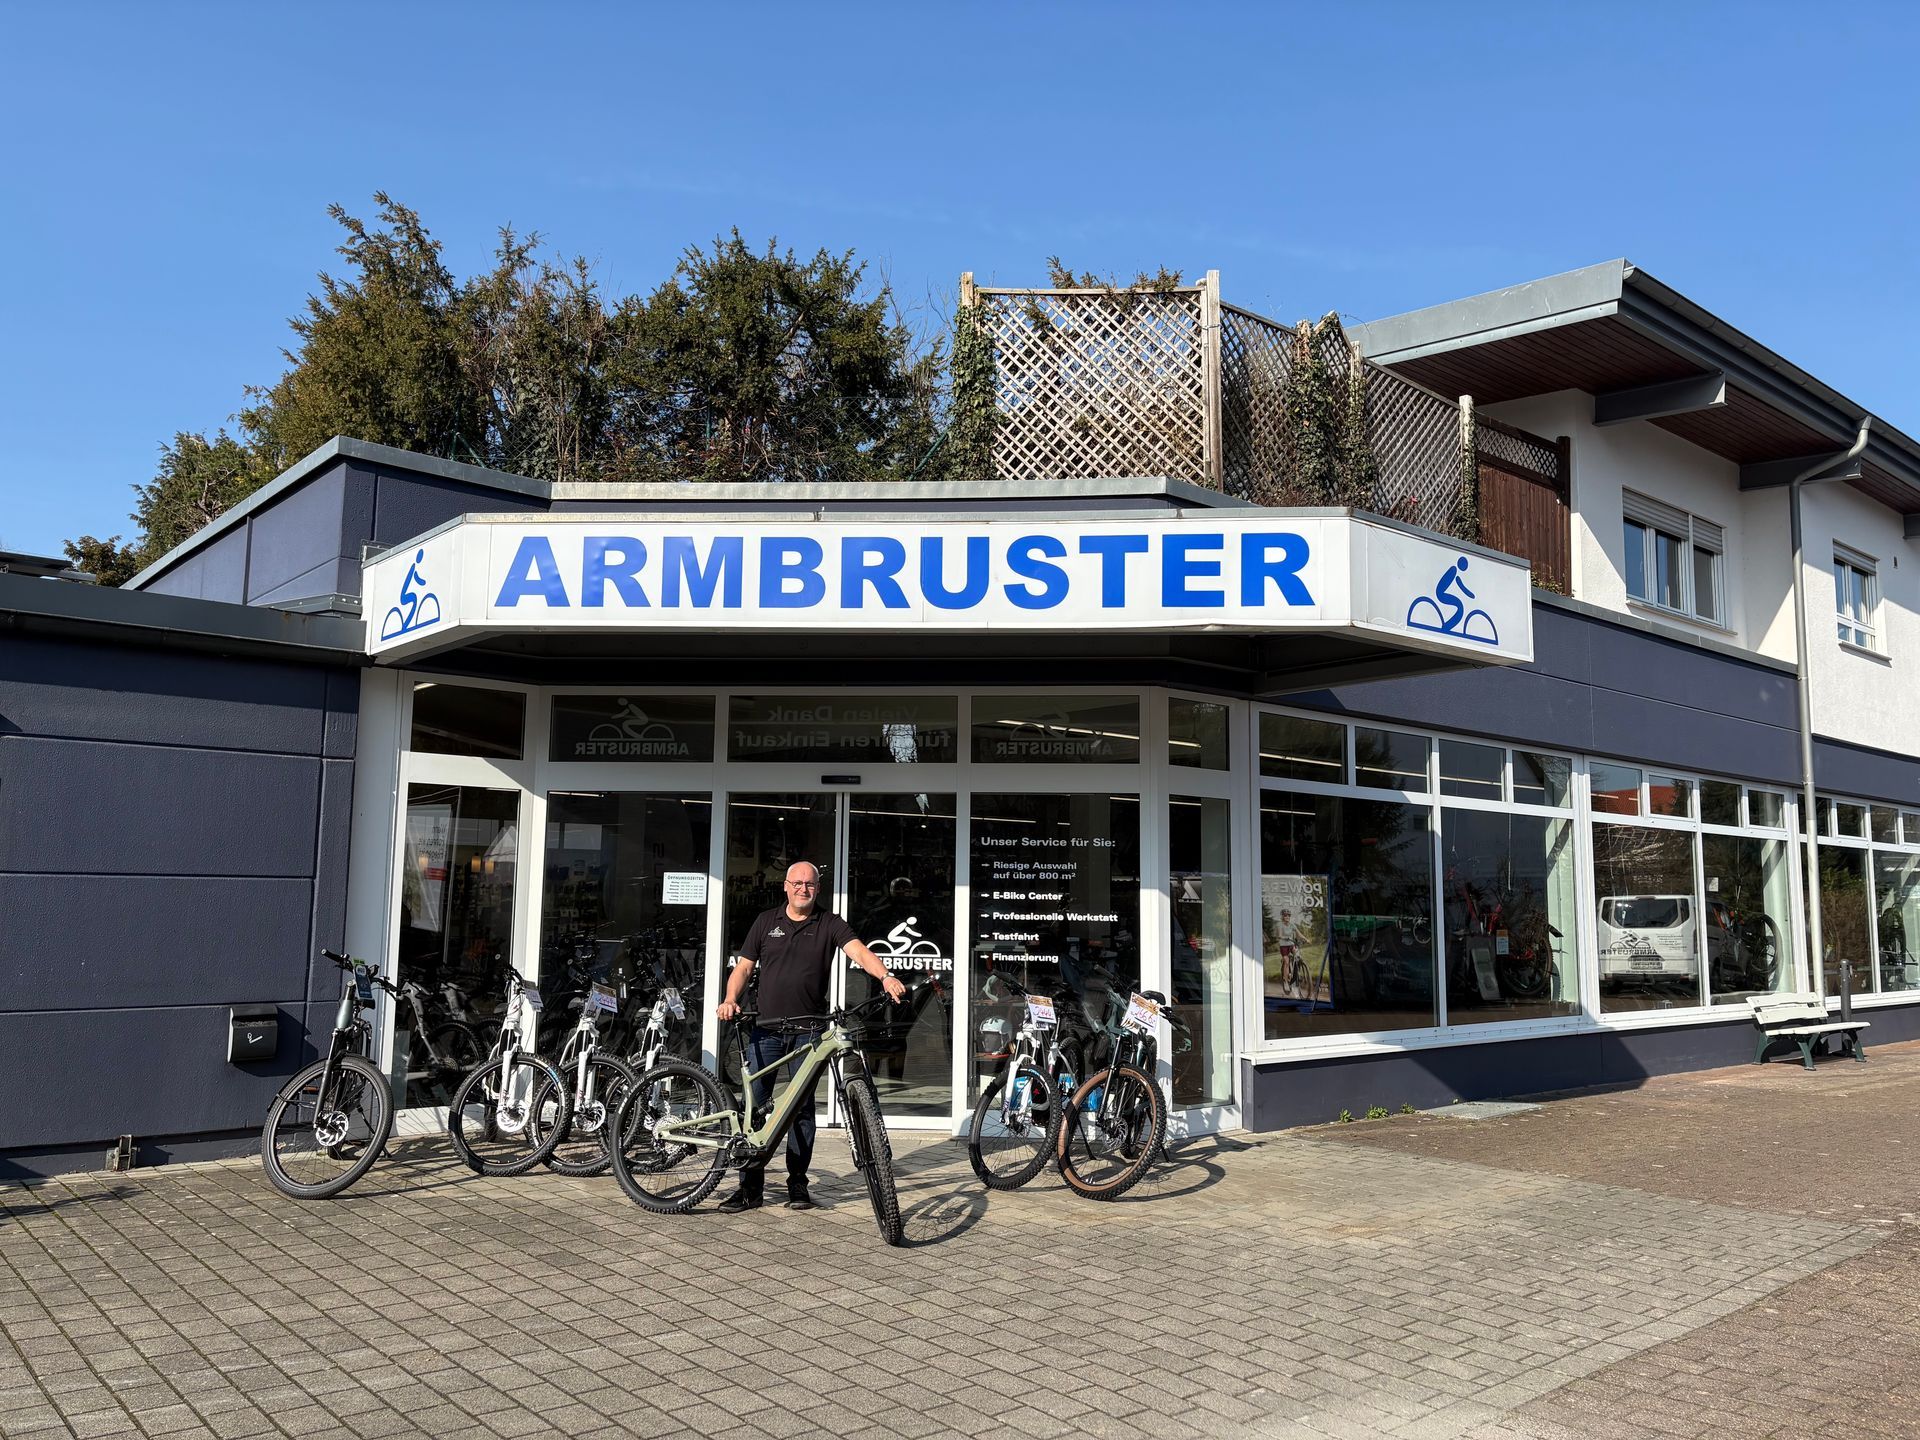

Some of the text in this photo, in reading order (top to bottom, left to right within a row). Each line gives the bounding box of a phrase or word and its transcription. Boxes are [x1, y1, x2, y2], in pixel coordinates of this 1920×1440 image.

[494, 532, 1315, 610] ARMBRUSTER
[981, 837, 1116, 847] Unser Service für Sie:
[993, 861, 1077, 871] Riesige Auswahl
[993, 871, 1010, 879] auf
[1013, 871, 1036, 879] über
[1039, 872, 1059, 880] 800
[993, 891, 1063, 901] E-Bike Center
[992, 912, 1119, 922] Professionelle Werkstatt
[992, 932, 1040, 941] Testfahrt
[992, 953, 1059, 964] Finanzierung
[849, 957, 953, 971] ABRUSTER
